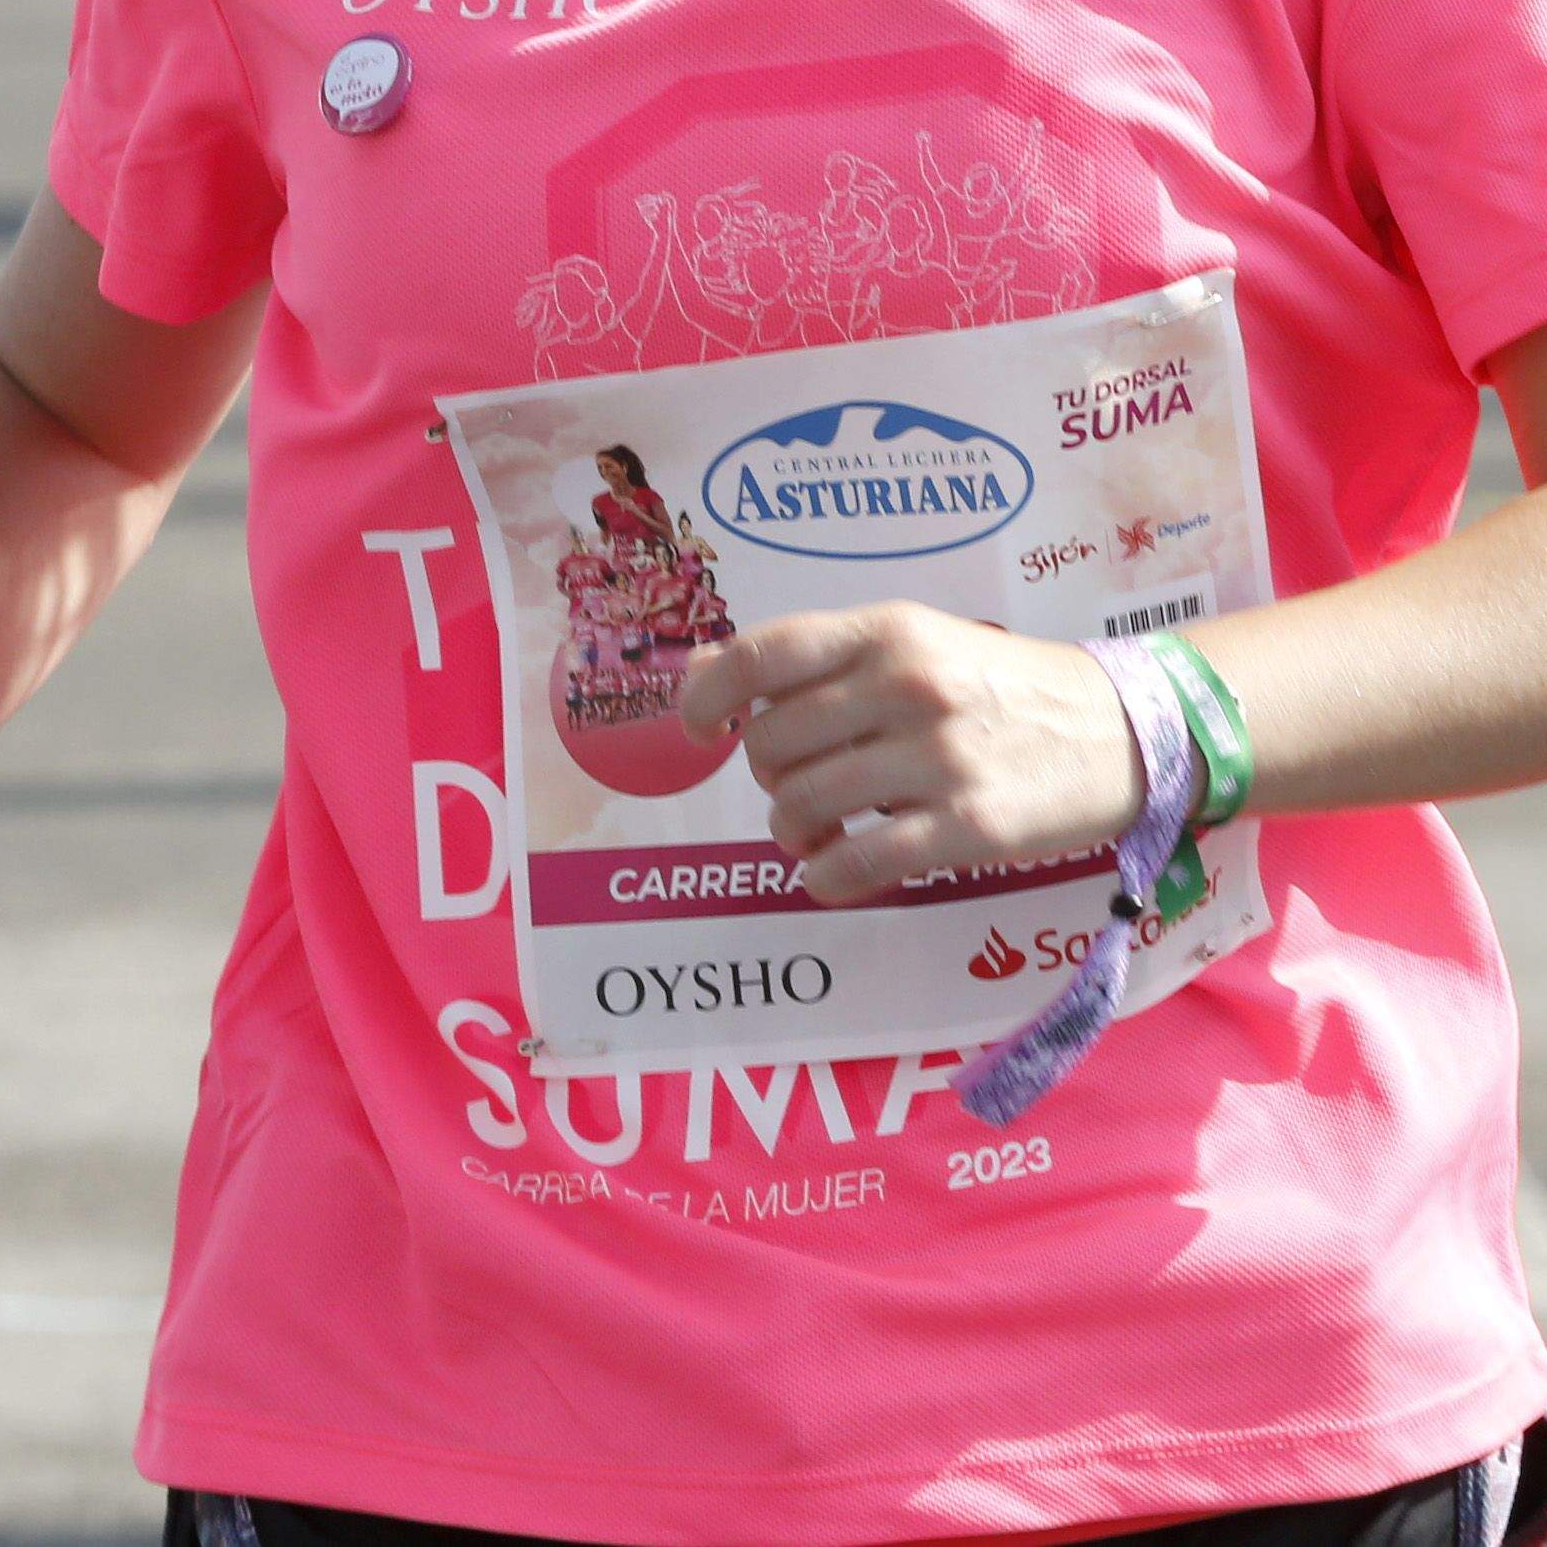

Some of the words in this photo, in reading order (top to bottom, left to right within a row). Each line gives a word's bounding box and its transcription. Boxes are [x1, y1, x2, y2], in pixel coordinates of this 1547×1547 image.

[1052, 386, 1086, 411] TU
[1095, 355, 1192, 402] DORSAL
[1060, 382, 1193, 449] SUMA
[773, 452, 878, 475] CENTRAL
[888, 448, 992, 467] LECHERA
[732, 463, 1011, 523] ASTURIANA
[1019, 534, 1099, 584] gijón
[595, 952, 833, 1018] OYSHO
[947, 1136, 1053, 1191] 2023
[744, 1166, 886, 1222] MUJER
